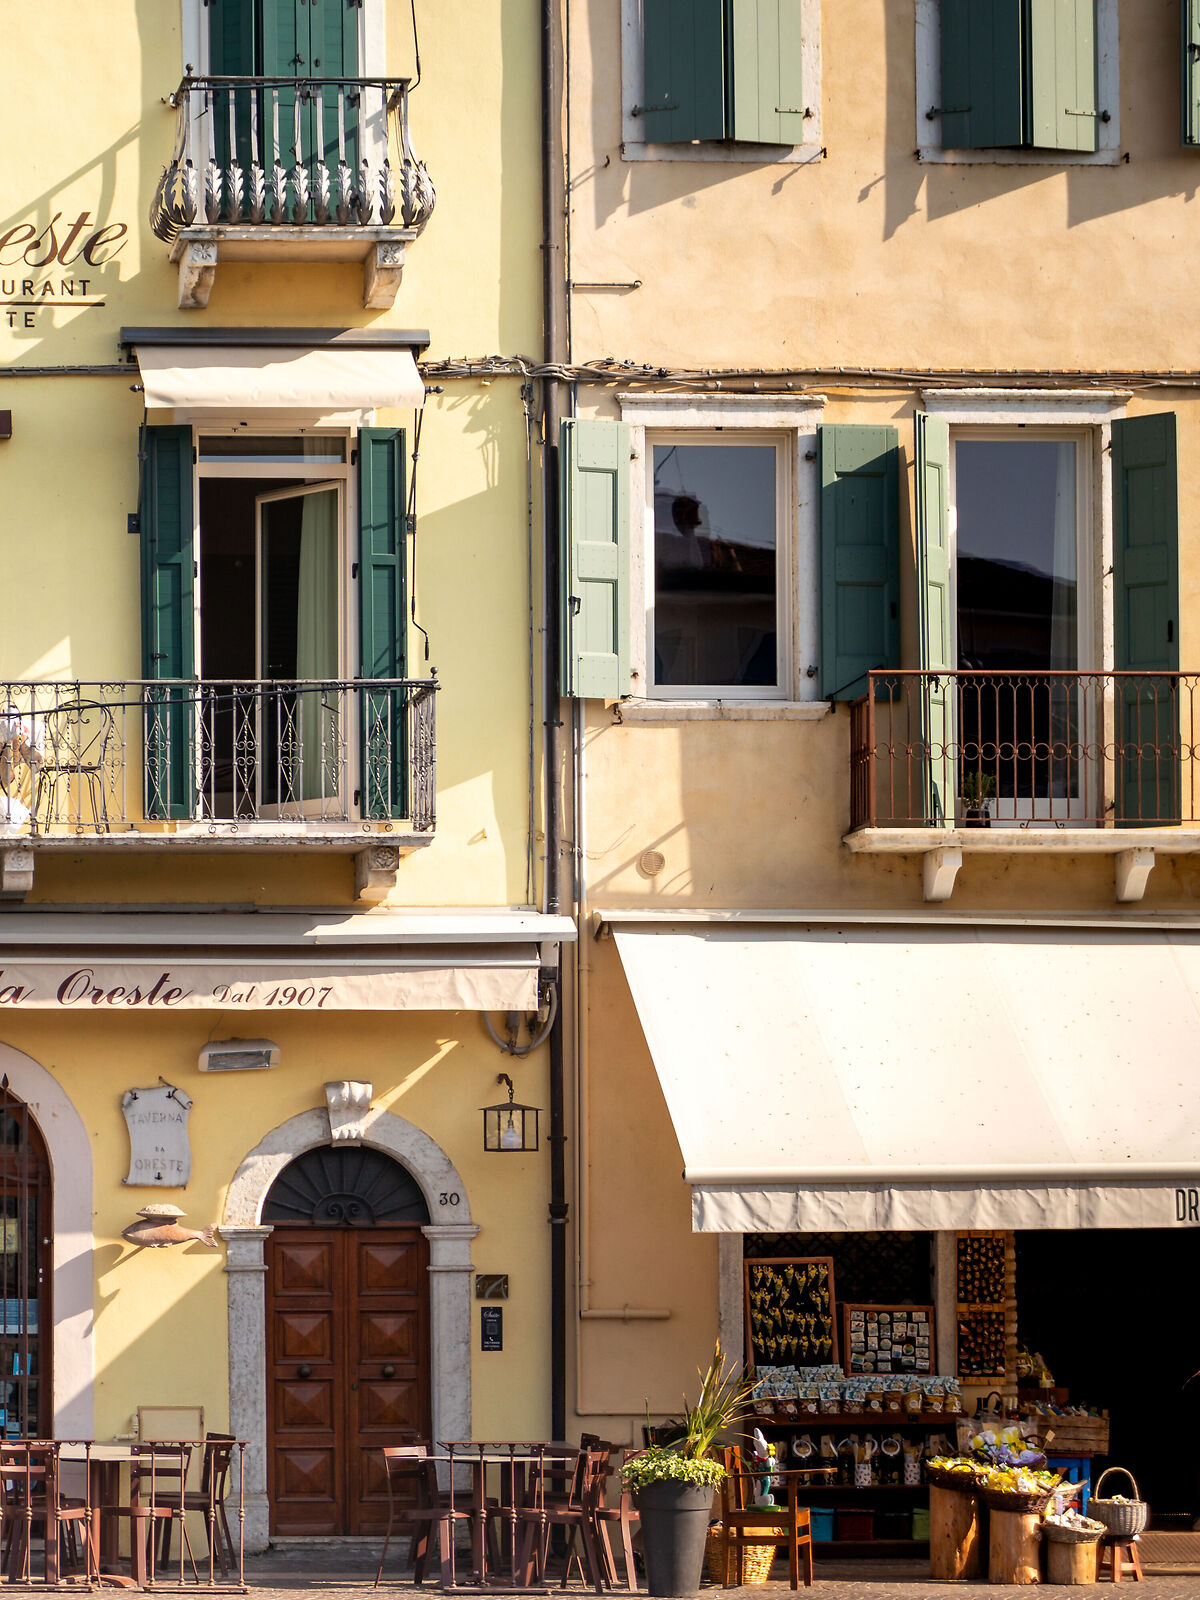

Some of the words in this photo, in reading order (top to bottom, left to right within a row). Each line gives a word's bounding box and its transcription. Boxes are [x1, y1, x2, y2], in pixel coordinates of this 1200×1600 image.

[57, 968, 194, 1006] Oreste
[213, 984, 256, 1003] Dal
[264, 986, 333, 1008] 1907
[131, 1111, 184, 1124] TAVERNA
[135, 1159, 184, 1173] ORESTE
[439, 1192, 460, 1206] 30
[1175, 1189, 1199, 1222] DR
